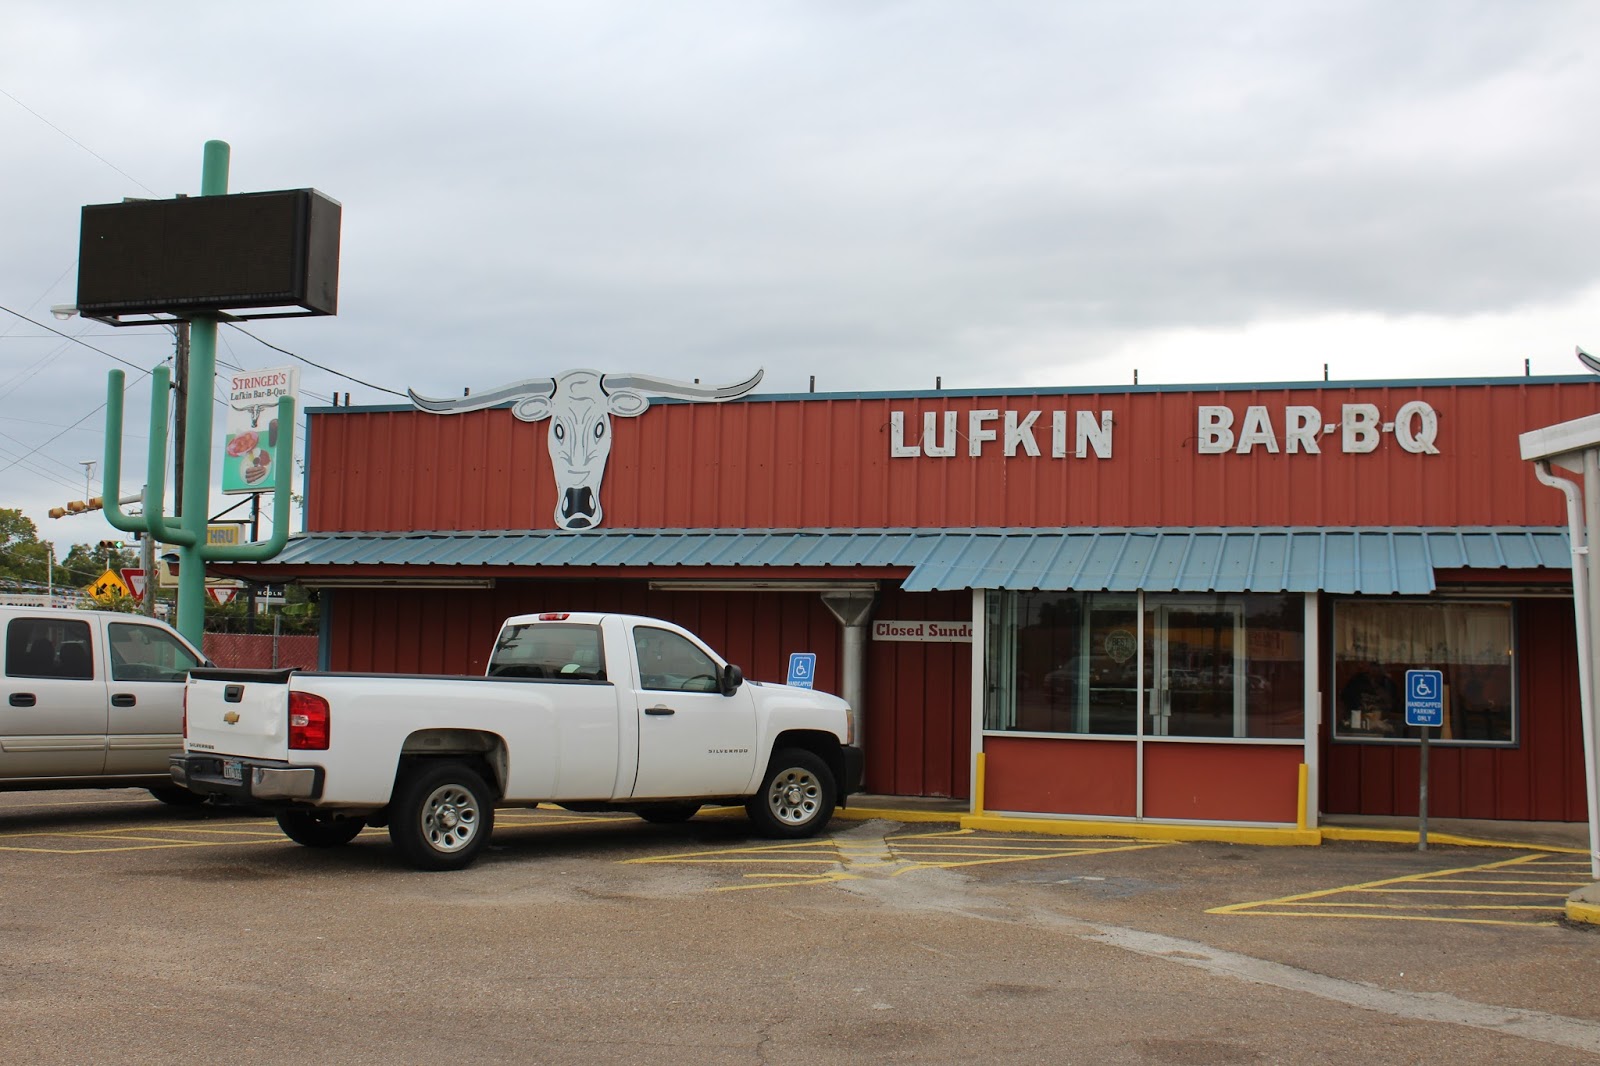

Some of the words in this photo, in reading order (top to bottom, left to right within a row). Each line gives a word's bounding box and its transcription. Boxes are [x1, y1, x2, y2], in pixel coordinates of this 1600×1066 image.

[232, 372, 286, 391] STRINGER'S
[230, 390, 252, 401] Lufkin
[253, 388, 286, 398] Bar-B-Que
[891, 409, 1113, 459] LUFKIN
[1198, 400, 1441, 455] BAR-B-Q
[207, 528, 234, 544] HRU
[876, 623, 924, 636] Closed
